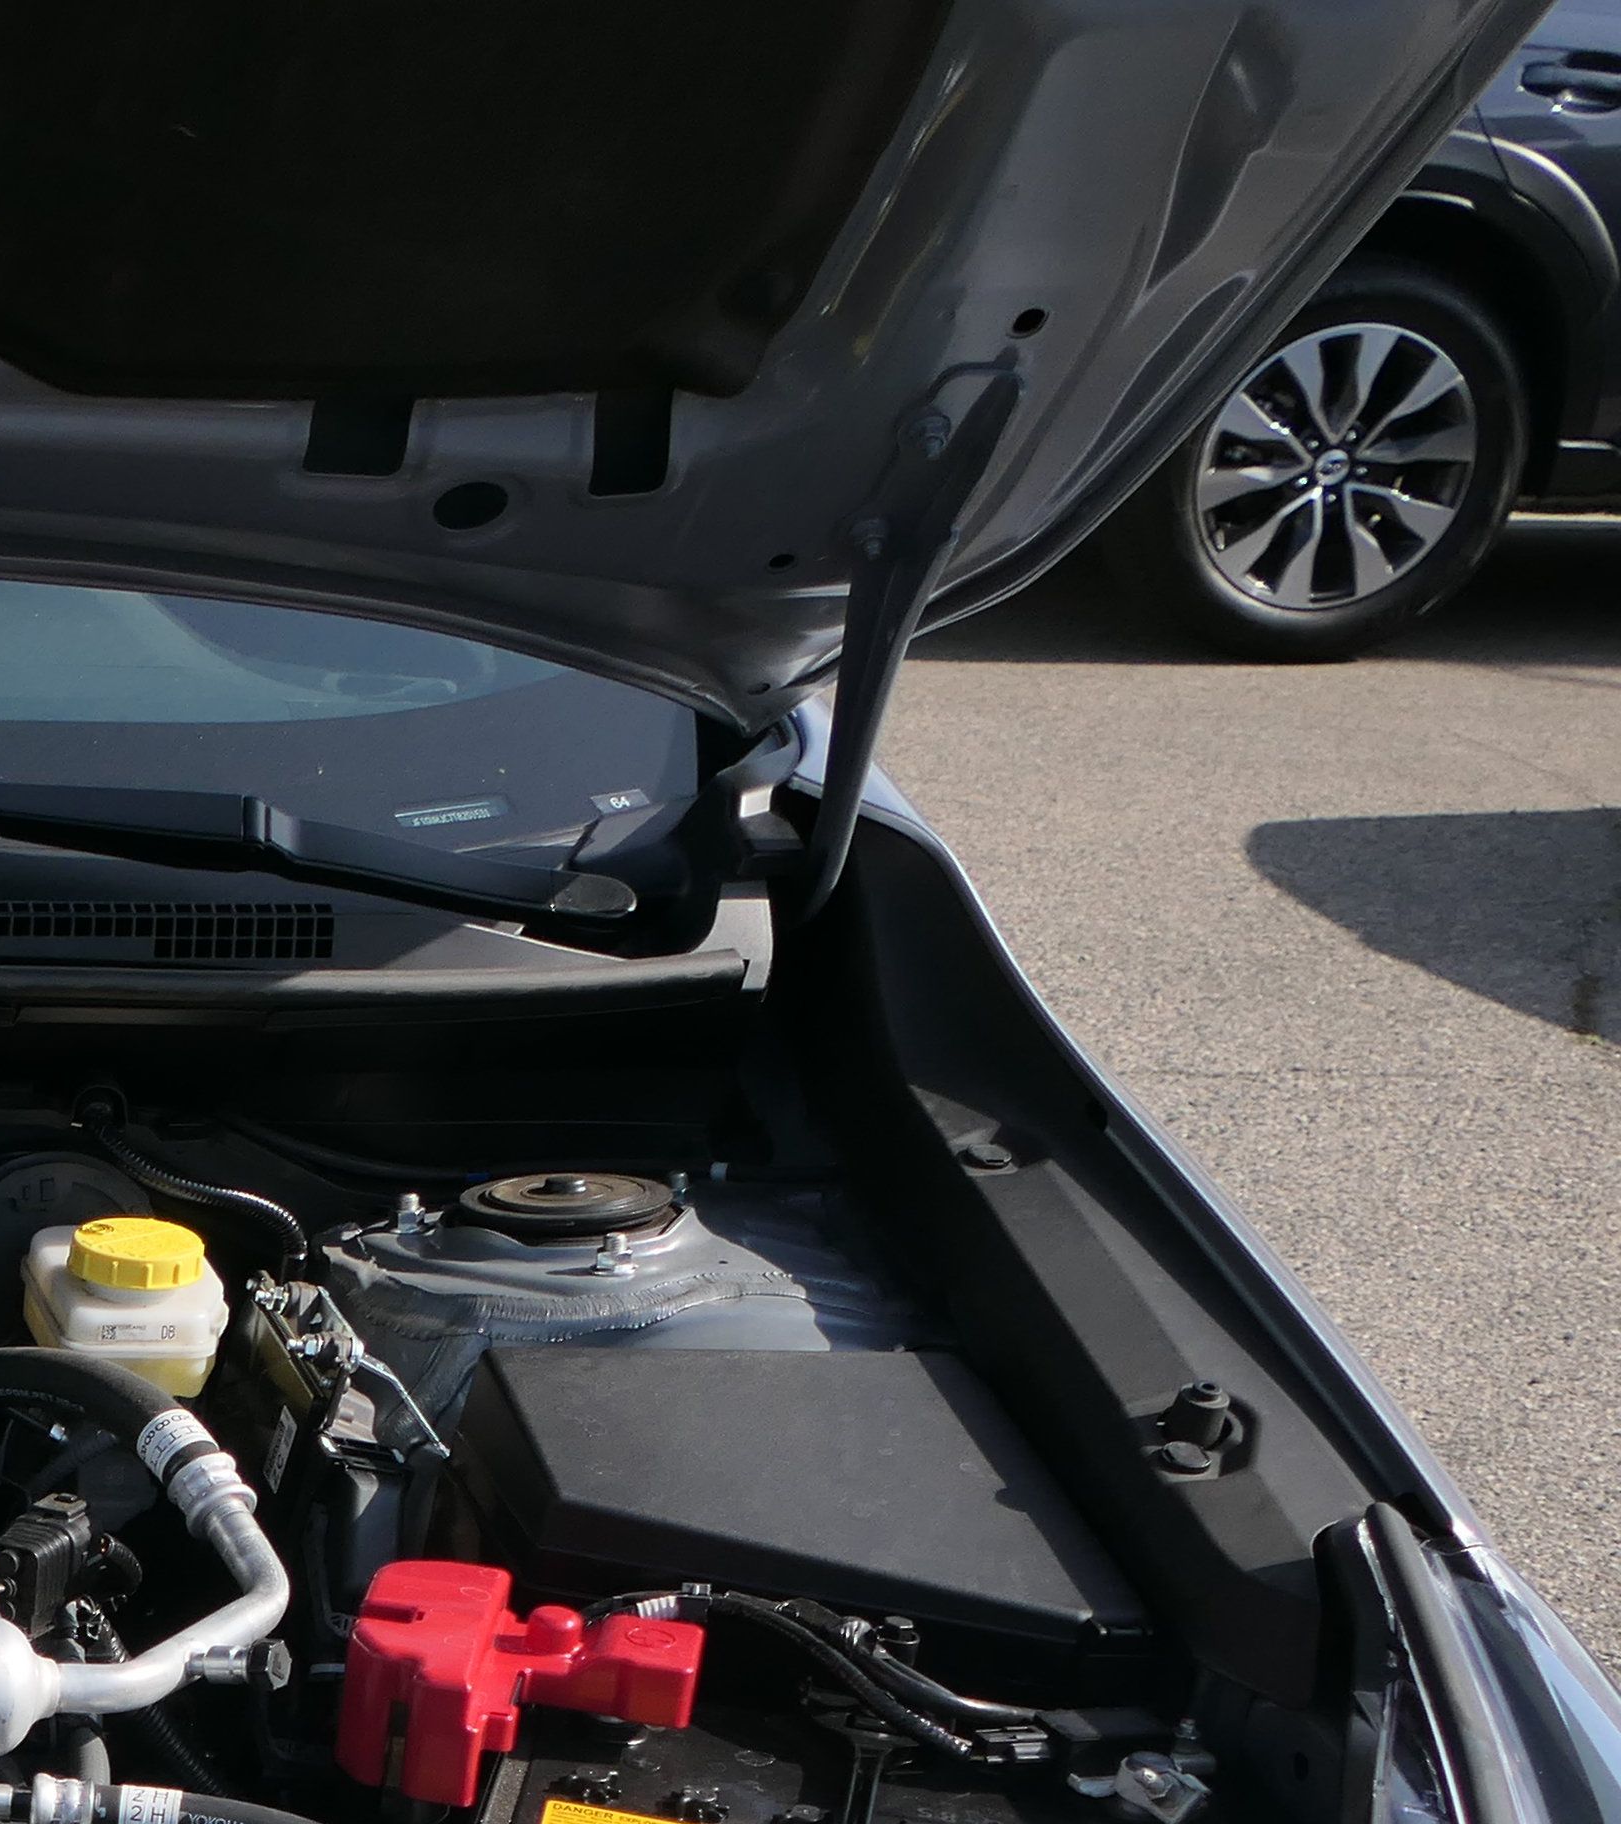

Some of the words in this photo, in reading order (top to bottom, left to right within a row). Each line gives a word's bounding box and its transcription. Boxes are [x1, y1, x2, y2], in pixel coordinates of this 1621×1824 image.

[130, 1806, 142, 1821] 2
[150, 1807, 166, 1824] H
[552, 1802, 614, 1820] DANGER
